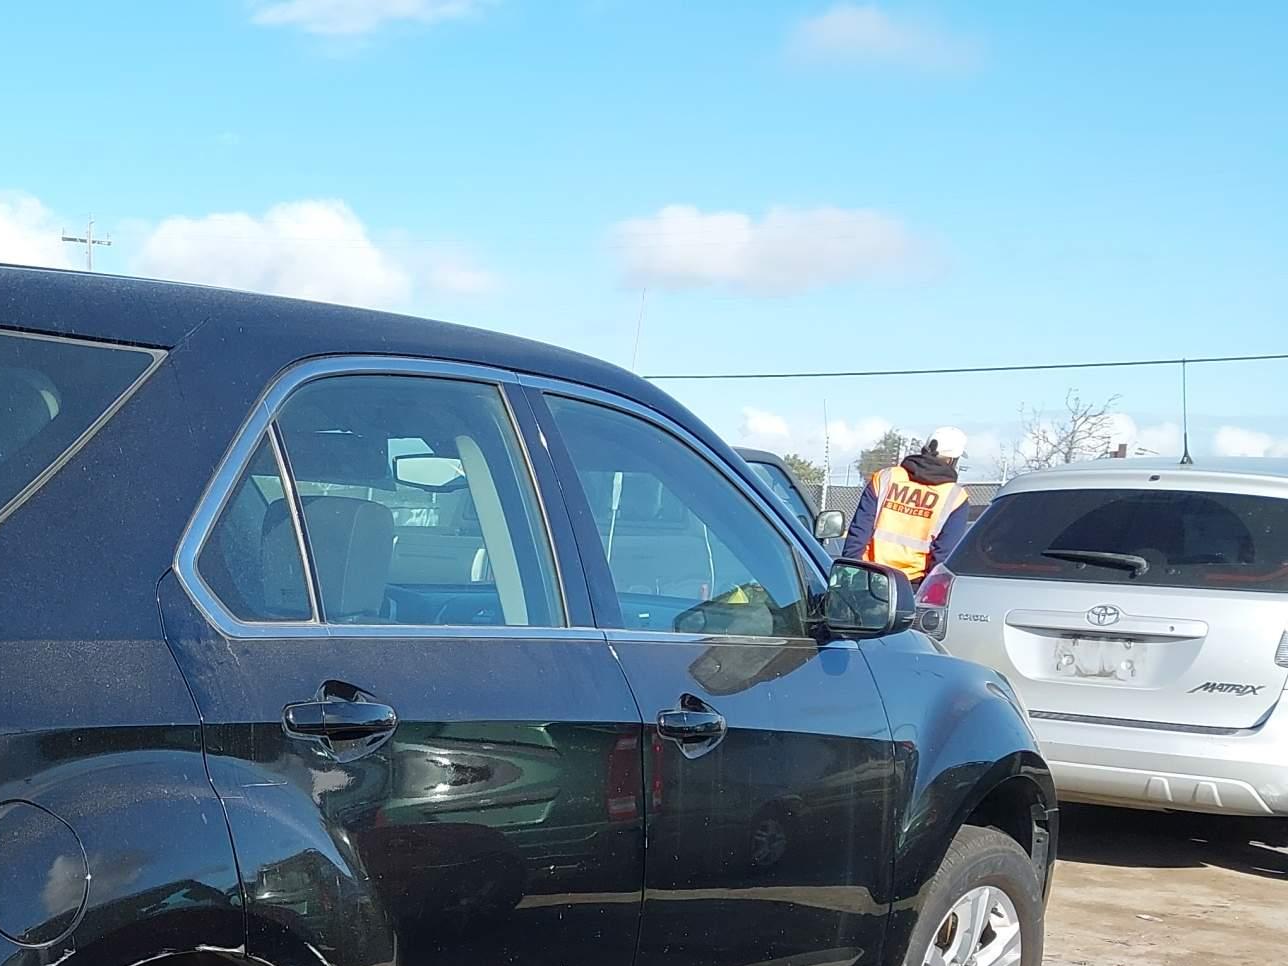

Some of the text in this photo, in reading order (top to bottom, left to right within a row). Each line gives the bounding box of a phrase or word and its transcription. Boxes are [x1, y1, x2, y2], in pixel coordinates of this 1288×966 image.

[886, 482, 939, 510] MAD
[885, 502, 933, 518] SERVICES
[1185, 681, 1266, 697] MATRIX
